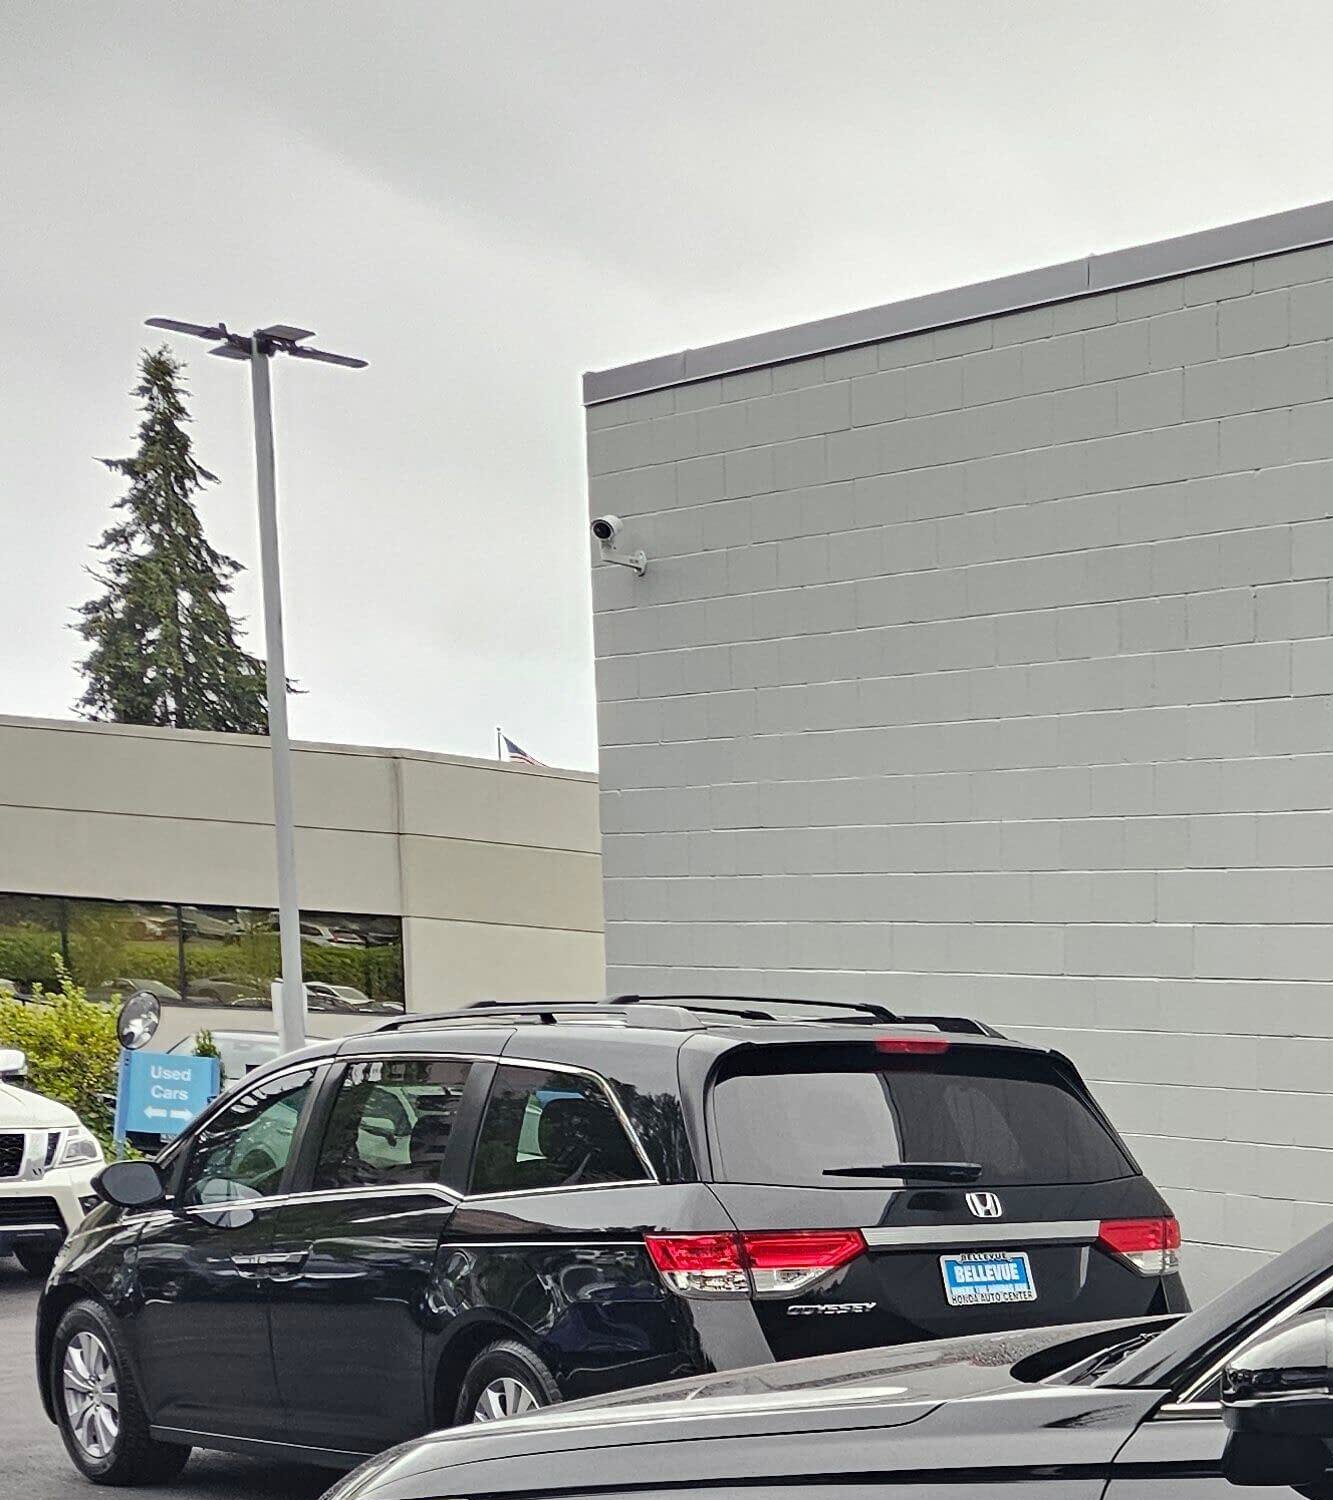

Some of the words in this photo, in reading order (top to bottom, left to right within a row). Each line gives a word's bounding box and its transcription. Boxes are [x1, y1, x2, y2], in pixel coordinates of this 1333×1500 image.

[151, 1064, 191, 1081] Used
[150, 1084, 189, 1101] Cars
[960, 1252, 1008, 1261] BELLEVUE
[953, 1262, 1020, 1283] BELLEVUE
[951, 1293, 979, 1305] HONDA
[980, 1291, 1001, 1302] AUTO
[1003, 1289, 1034, 1300] CENTER
